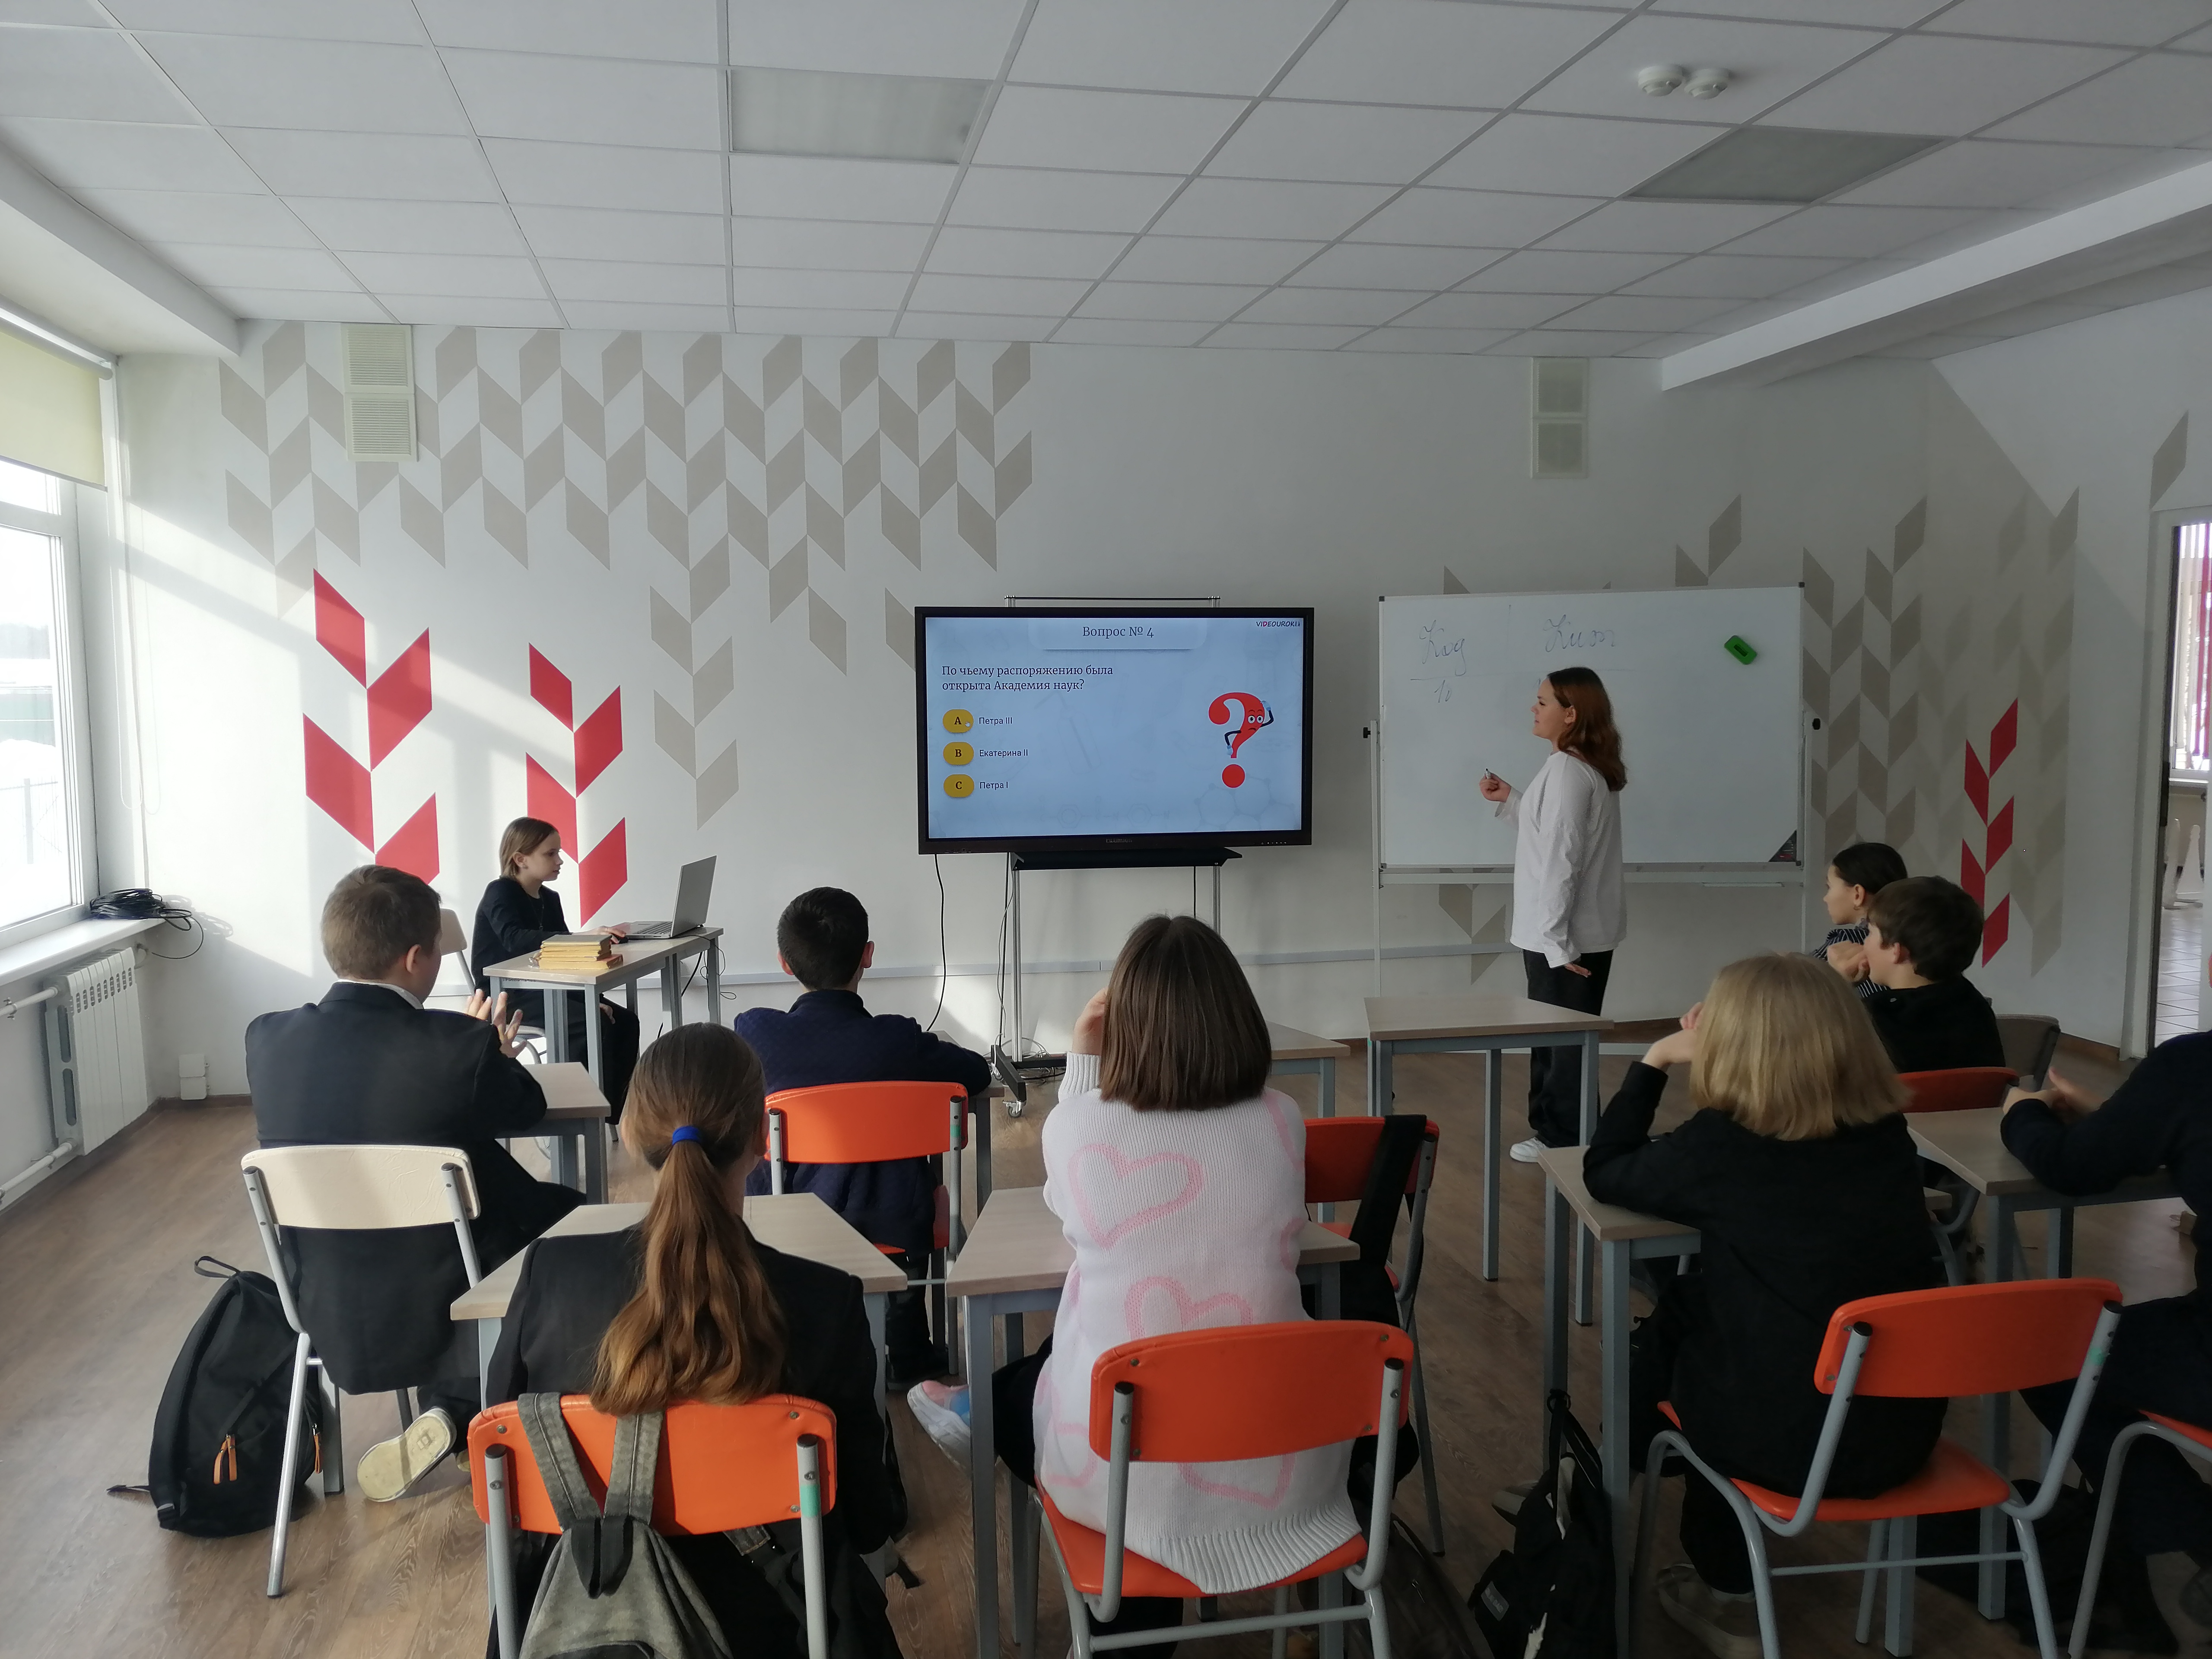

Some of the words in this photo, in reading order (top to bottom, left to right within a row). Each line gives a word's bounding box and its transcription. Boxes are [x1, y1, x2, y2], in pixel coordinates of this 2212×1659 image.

[1083, 626, 1125, 639] Вопрос
[1129, 626, 1143, 636] №
[1147, 627, 1154, 638] 4
[942, 666, 957, 675] По
[959, 668, 995, 677] чьему
[997, 666, 1083, 677] распоряжению
[1086, 664, 1113, 675] была
[942, 683, 991, 693] открыта
[994, 681, 1051, 692] Академия
[1053, 679, 1085, 692] наук?
[979, 717, 1003, 726] Петра
[979, 749, 1021, 758] Екатерина
[980, 782, 1004, 791] Петра
